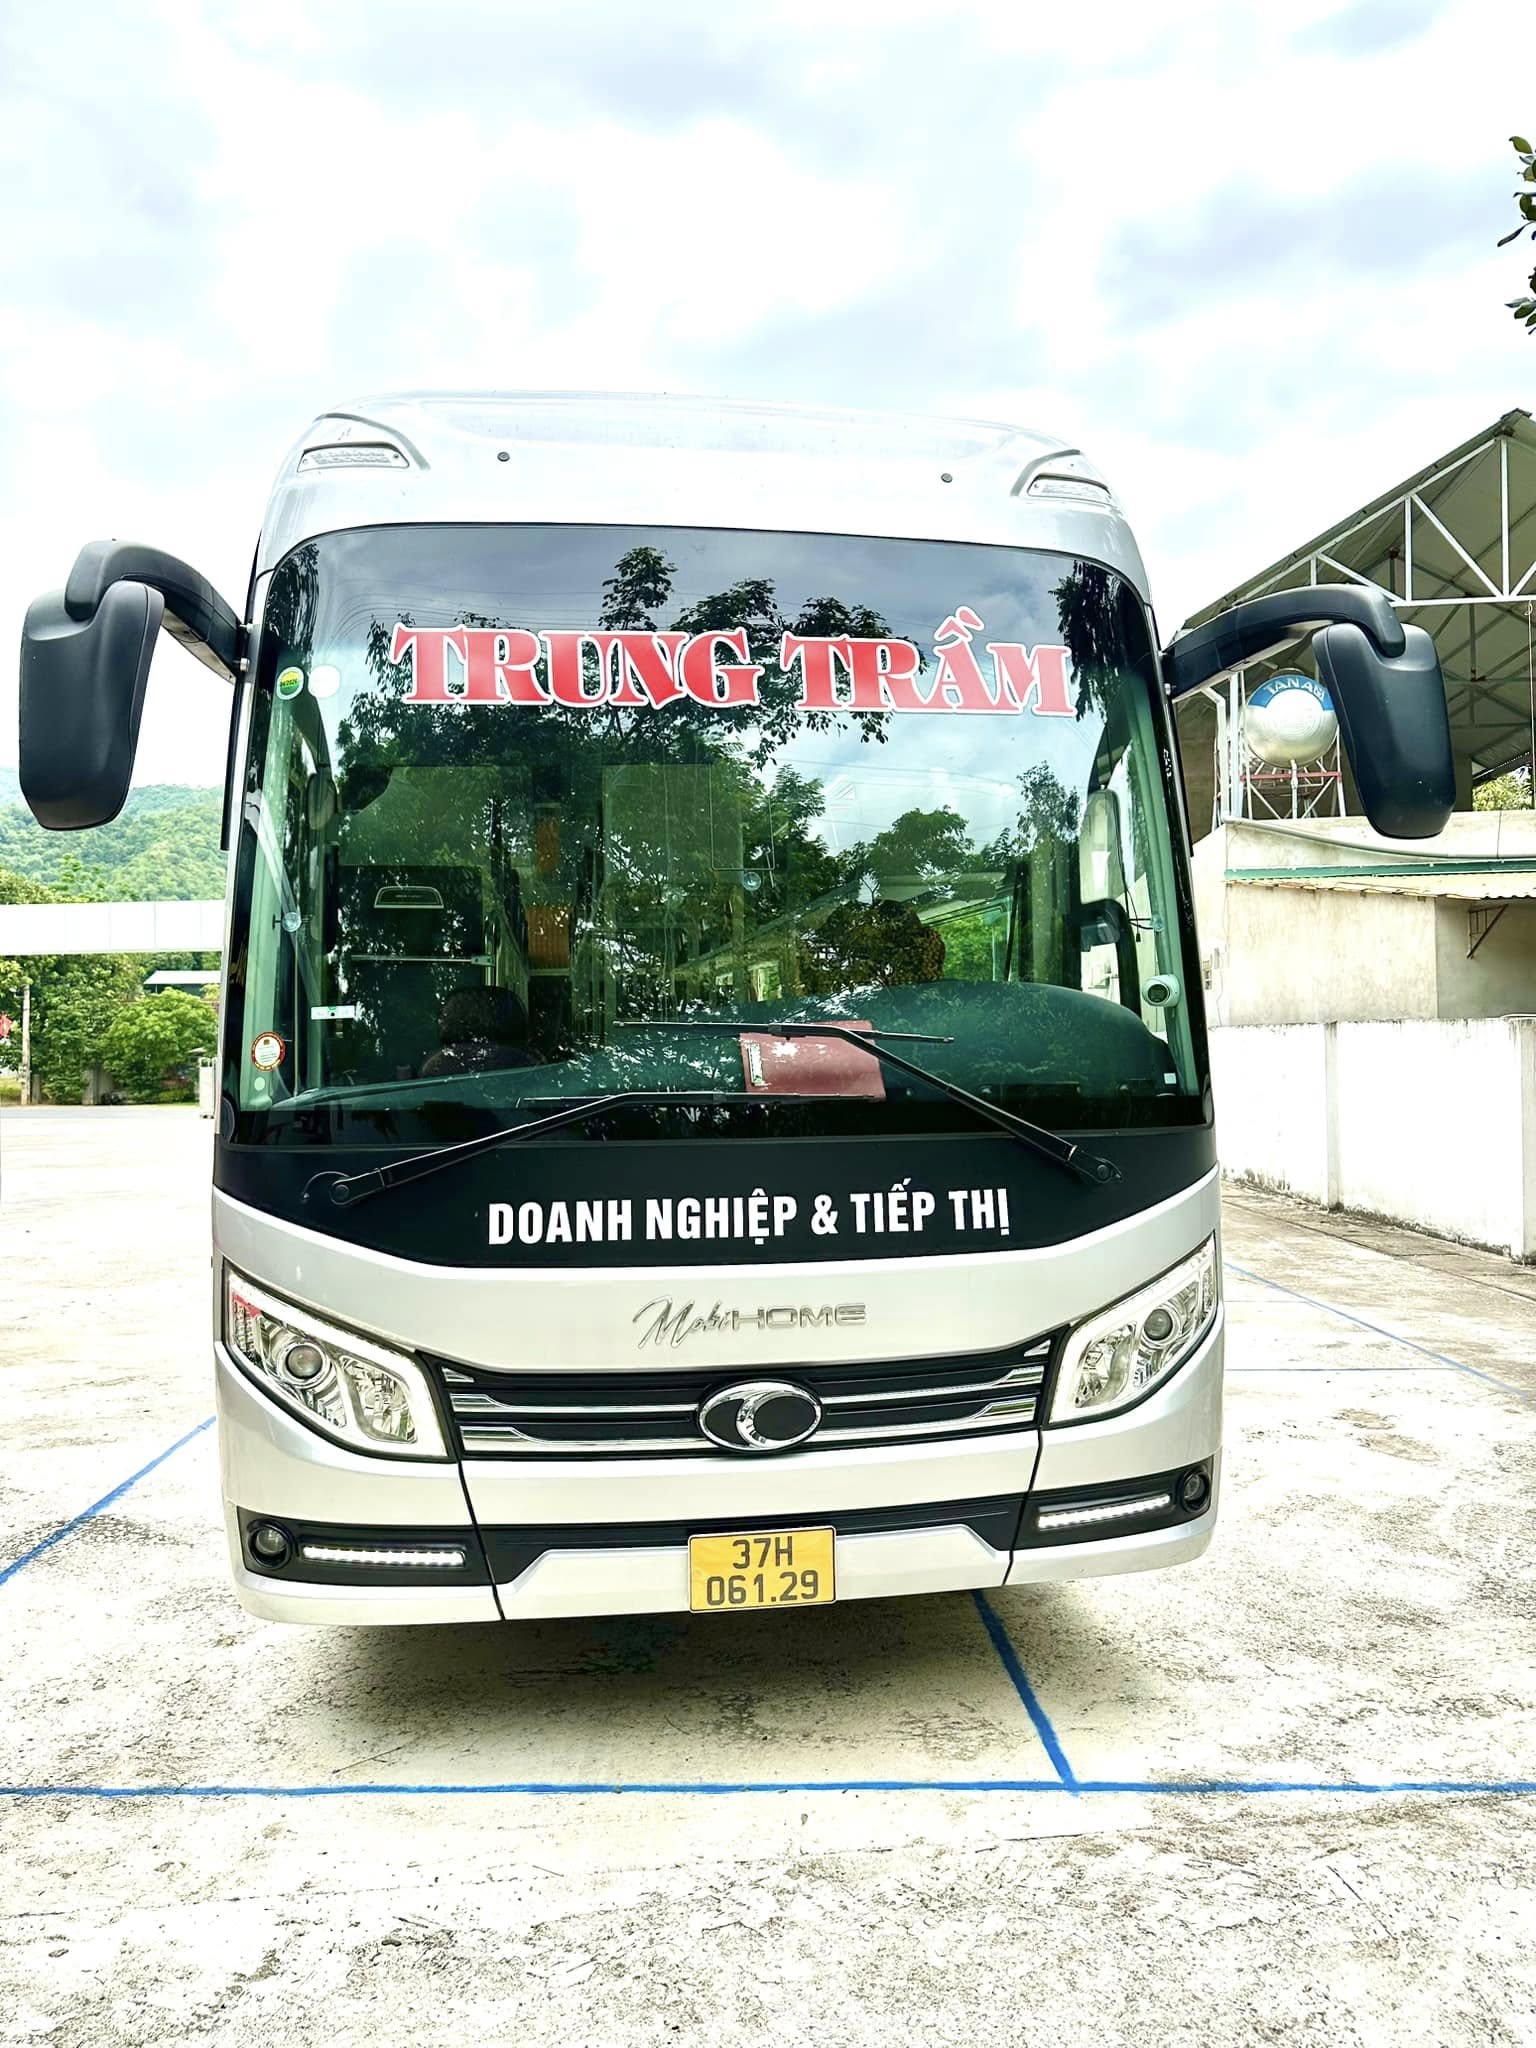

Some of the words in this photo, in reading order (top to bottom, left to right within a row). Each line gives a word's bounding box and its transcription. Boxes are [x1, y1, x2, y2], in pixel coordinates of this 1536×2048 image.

[388, 621, 766, 709] TRUNG
[779, 605, 1077, 717] TRẦM
[489, 1200, 631, 1244] DOANH
[647, 1189, 796, 1244] NGHIỆP
[811, 1195, 838, 1234] &
[850, 1178, 935, 1232] TIẾP
[949, 1189, 1009, 1235] THỊ
[732, 1536, 793, 1569] 37H
[706, 1570, 819, 1606] 061.29
